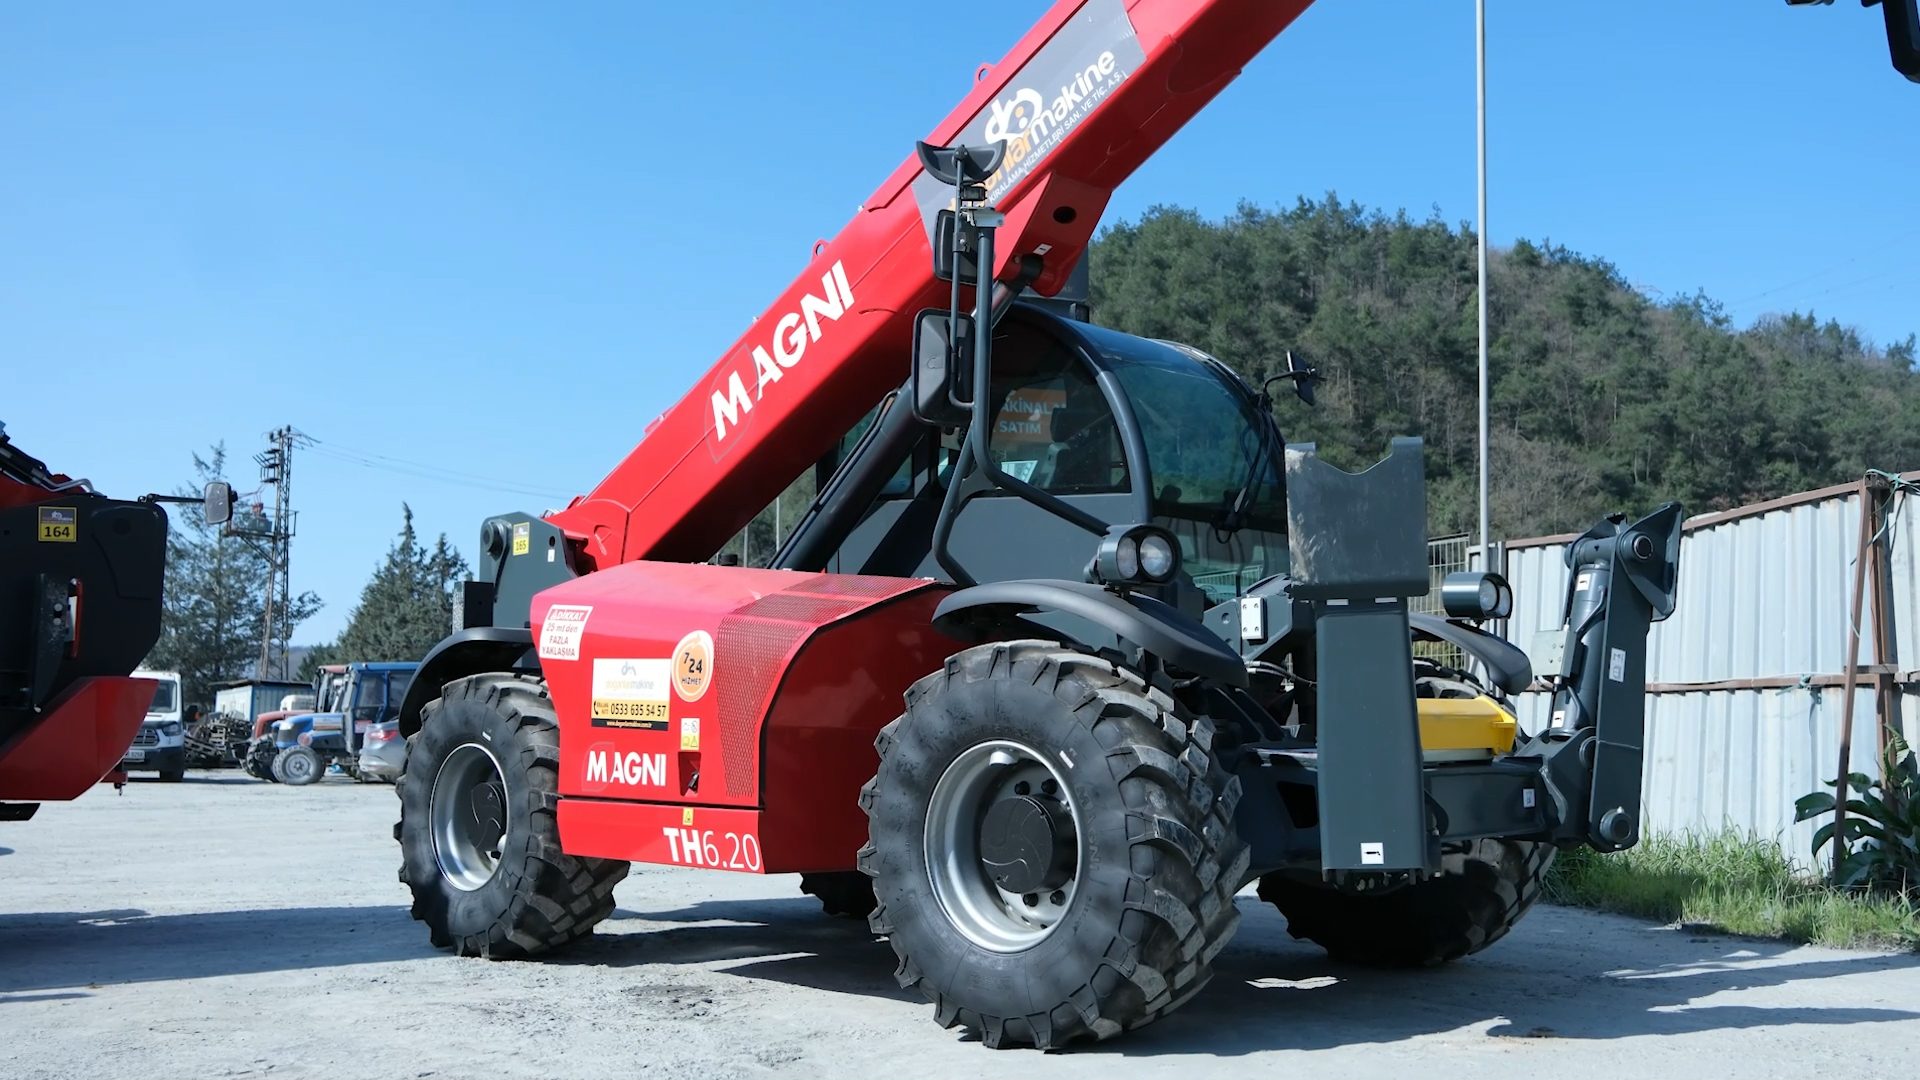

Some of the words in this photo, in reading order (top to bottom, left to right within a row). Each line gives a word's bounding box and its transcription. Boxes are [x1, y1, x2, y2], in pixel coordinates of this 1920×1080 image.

[1080, 100, 1093, 113] VE
[710, 259, 855, 442] MAGNI
[999, 420, 1041, 434] SATIM
[44, 526, 70, 538] 164
[515, 540, 527, 551] 165
[546, 622, 556, 632] 25
[549, 635, 569, 645] FAZLA
[684, 652, 690, 664] 7
[688, 658, 703, 674] 24
[610, 703, 628, 716] 0533
[630, 704, 644, 717] 635
[646, 705, 655, 717] 54
[657, 705, 667, 718] 57
[587, 751, 667, 786] MAGNI
[663, 827, 761, 871] TH6.20
